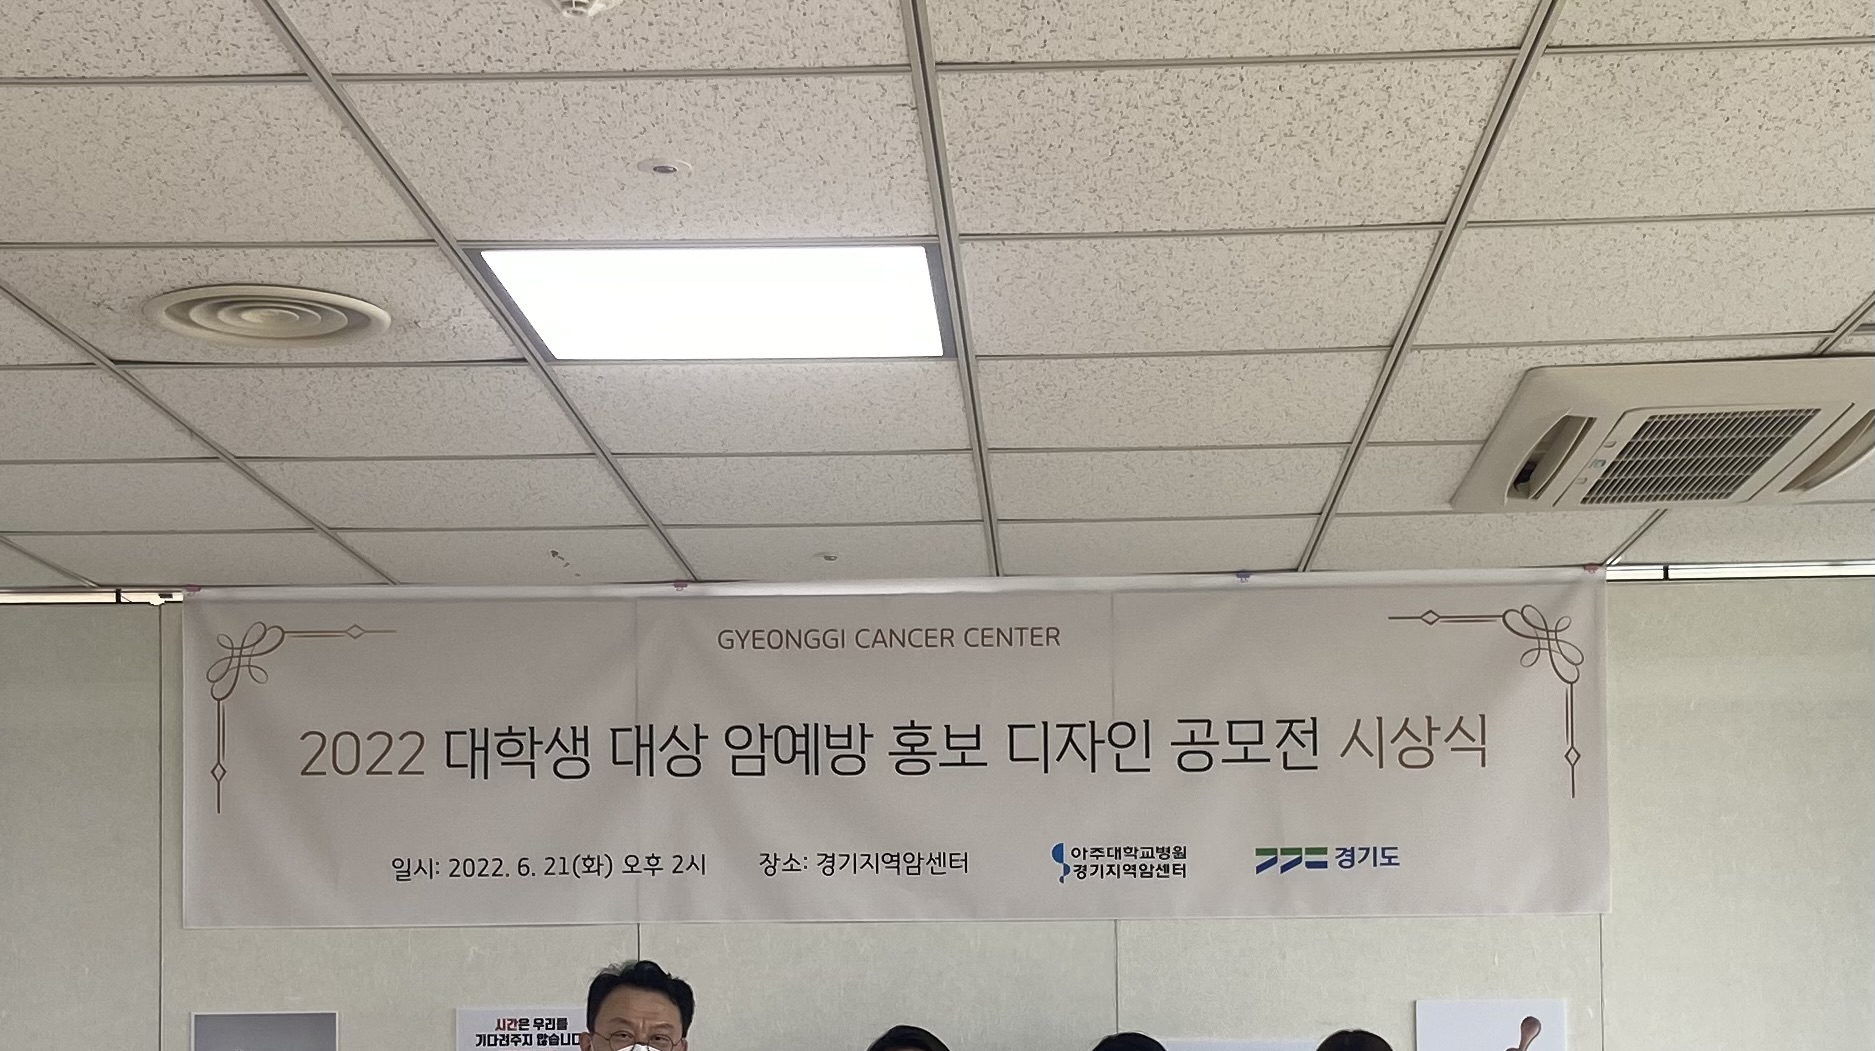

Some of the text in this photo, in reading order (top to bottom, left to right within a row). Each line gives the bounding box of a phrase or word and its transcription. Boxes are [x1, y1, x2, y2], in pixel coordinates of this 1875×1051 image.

[717, 625, 1061, 651] GYEONGGI CANCER CENTER
[299, 713, 1488, 781] 2022 대학생 대상 암예방 홍보 디자인 공모전 시상식
[758, 851, 969, 877] 장소: 경기지역암센터
[1070, 845, 1188, 861] 아주대학교병원
[1335, 845, 1401, 869] 경기도
[391, 853, 707, 882] 일시: 2022. 6. 21(화) 오후 2시
[1072, 862, 1188, 880] 경기지역암센터
[495, 1017, 568, 1032] 시간은 우리를
[475, 1033, 533, 1047] 기다려주지
